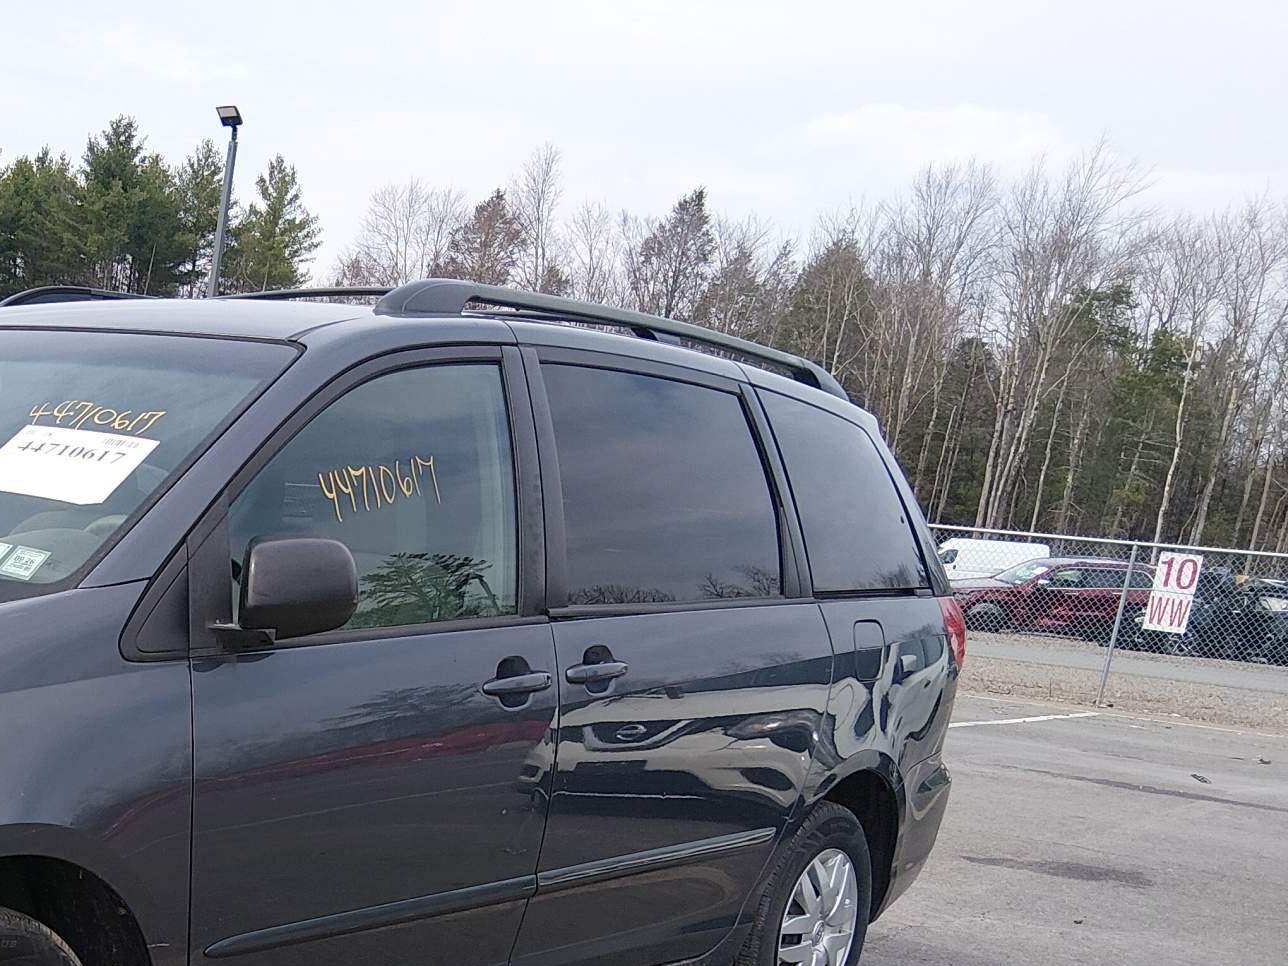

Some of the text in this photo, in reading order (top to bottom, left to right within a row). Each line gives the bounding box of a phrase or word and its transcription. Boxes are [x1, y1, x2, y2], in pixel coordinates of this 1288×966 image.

[29, 400, 167, 435] 44710617
[17, 441, 127, 465] 44710617
[318, 455, 441, 522] 44710617
[1162, 557, 1198, 589] 10
[1149, 596, 1191, 627] WW
